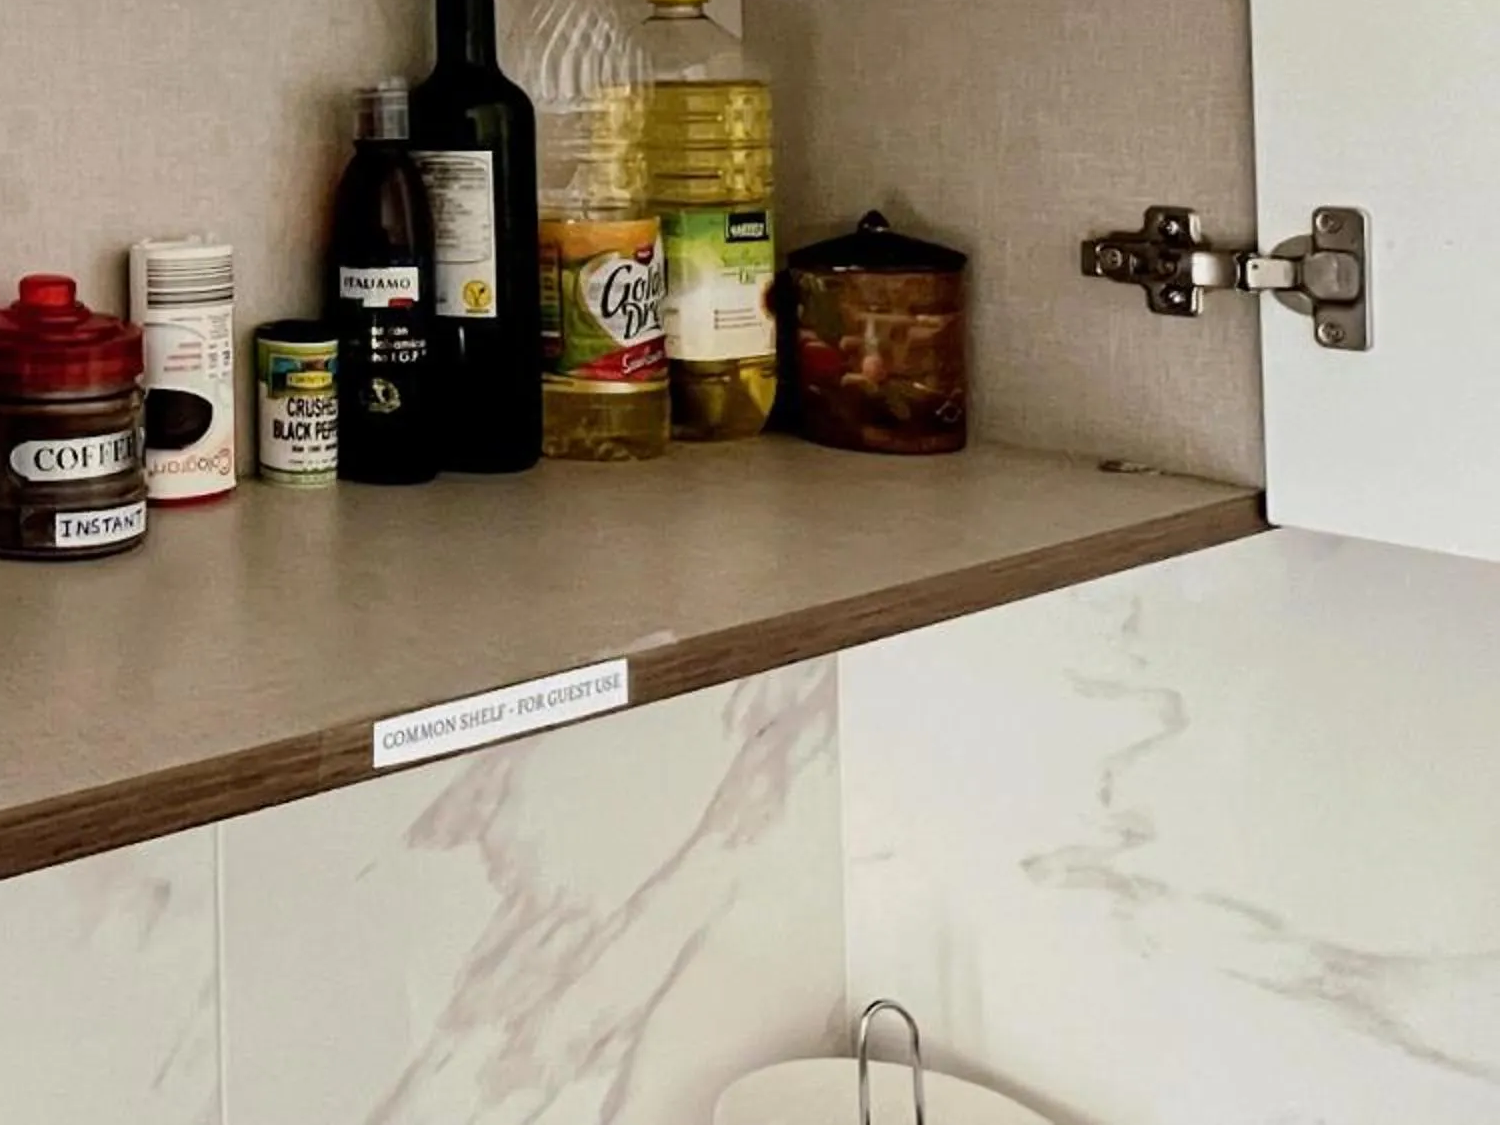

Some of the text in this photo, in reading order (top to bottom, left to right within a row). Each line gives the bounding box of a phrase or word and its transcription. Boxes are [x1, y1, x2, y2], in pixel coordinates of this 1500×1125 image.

[287, 397, 337, 417] CRUSHE
[273, 418, 311, 441] BLACK
[60, 508, 143, 538] INSTANT
[382, 715, 457, 750] COMMON
[459, 703, 506, 731] SHELF
[517, 693, 546, 715] FOR
[547, 680, 592, 707] GUEST
[595, 672, 622, 694] USE
